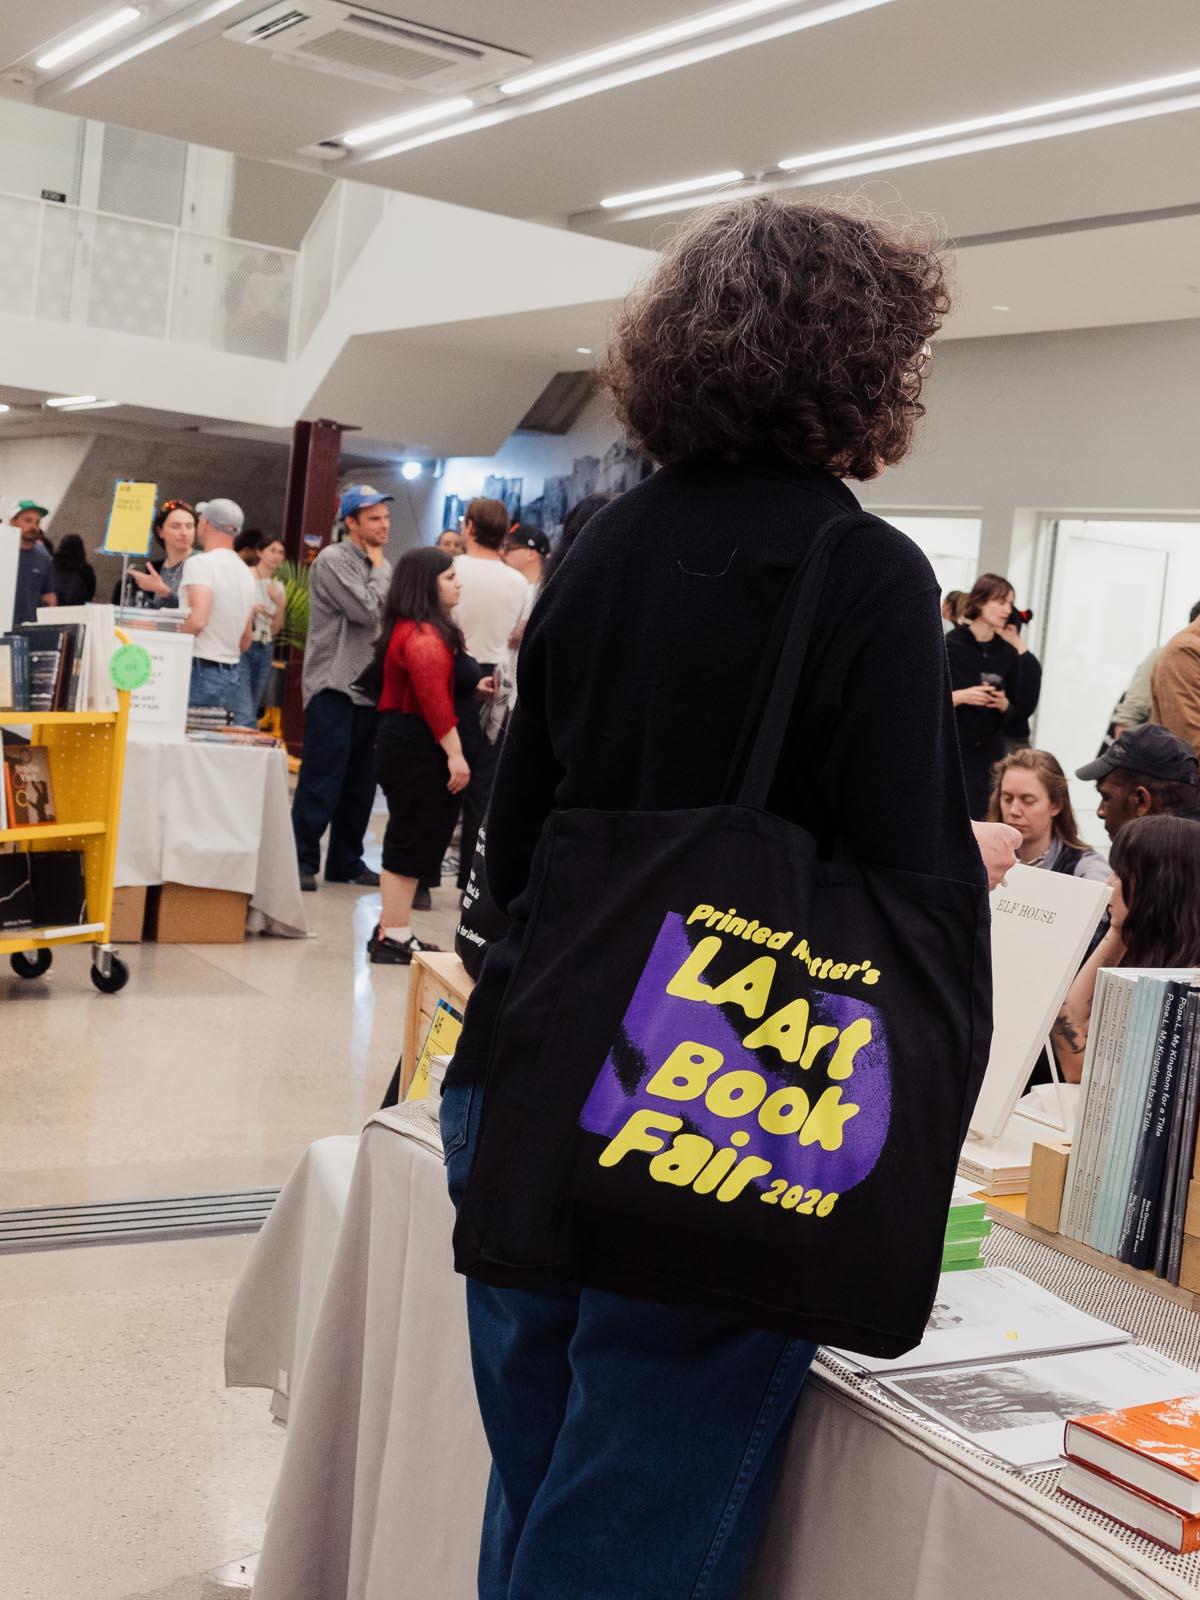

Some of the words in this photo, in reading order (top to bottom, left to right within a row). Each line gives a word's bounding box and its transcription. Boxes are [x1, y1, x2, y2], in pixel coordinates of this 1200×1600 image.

[996, 899, 1020, 914] ELF
[1019, 904, 1057, 924] HOUSE
[686, 904, 794, 950] Printed
[791, 939, 881, 985] Mtter's
[666, 935, 777, 1019] LA
[742, 998, 872, 1080] Art
[1122, 988, 1132, 1023] Discovery
[1158, 1029, 1167, 1043] My
[1171, 1033, 1179, 1047] My
[1150, 1044, 1164, 1086] Kingdom
[1163, 1049, 1176, 1091] Kingdom
[646, 1041, 860, 1151] Book
[1148, 1087, 1156, 1101] for
[1161, 1092, 1169, 1106] for
[1143, 1111, 1151, 1132] Title
[1156, 1116, 1165, 1137] Title
[598, 1109, 773, 1203] Fair
[760, 1179, 839, 1217] 2026
[1087, 1192, 1097, 1233] Documents
[1139, 1212, 1149, 1241] Documents
